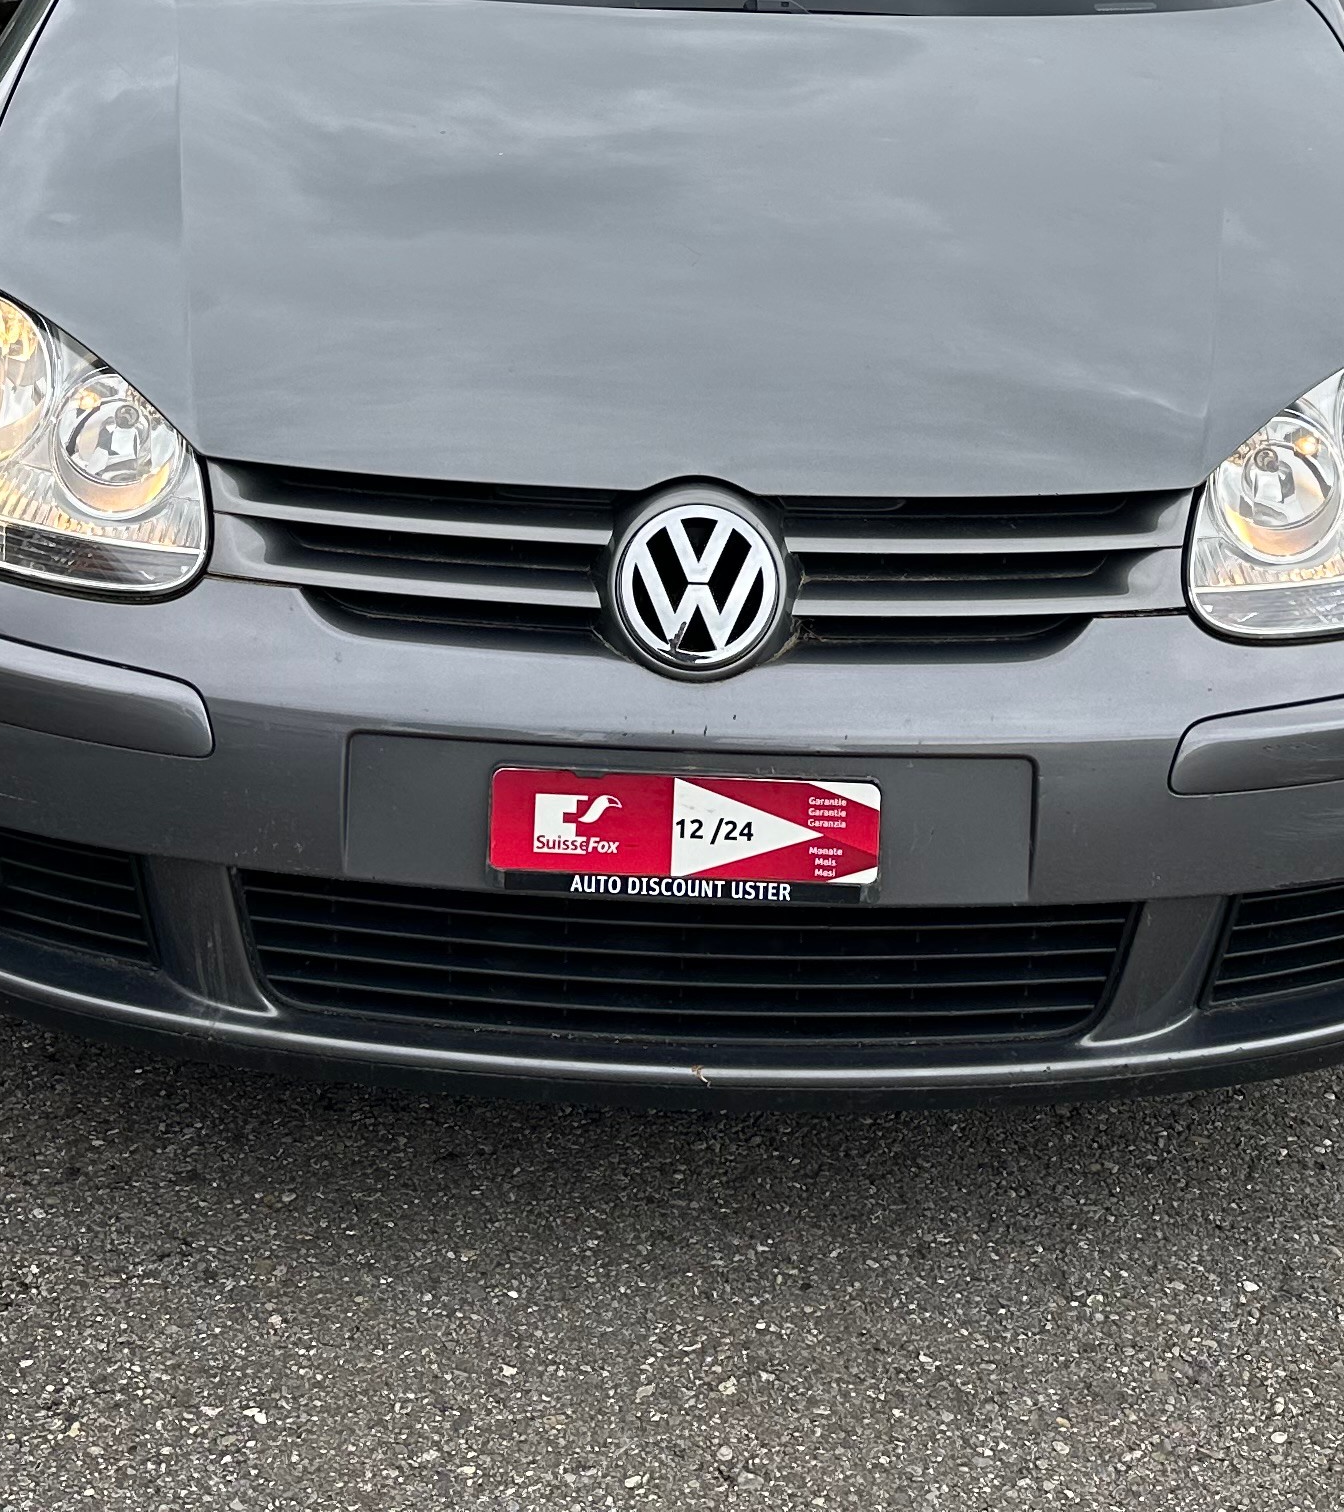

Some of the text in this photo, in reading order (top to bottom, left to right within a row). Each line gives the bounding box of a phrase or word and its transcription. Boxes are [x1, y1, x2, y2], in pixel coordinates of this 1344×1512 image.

[620, 504, 777, 664] VW
[570, 875, 791, 901] AUTO DISCOUNT USTER
